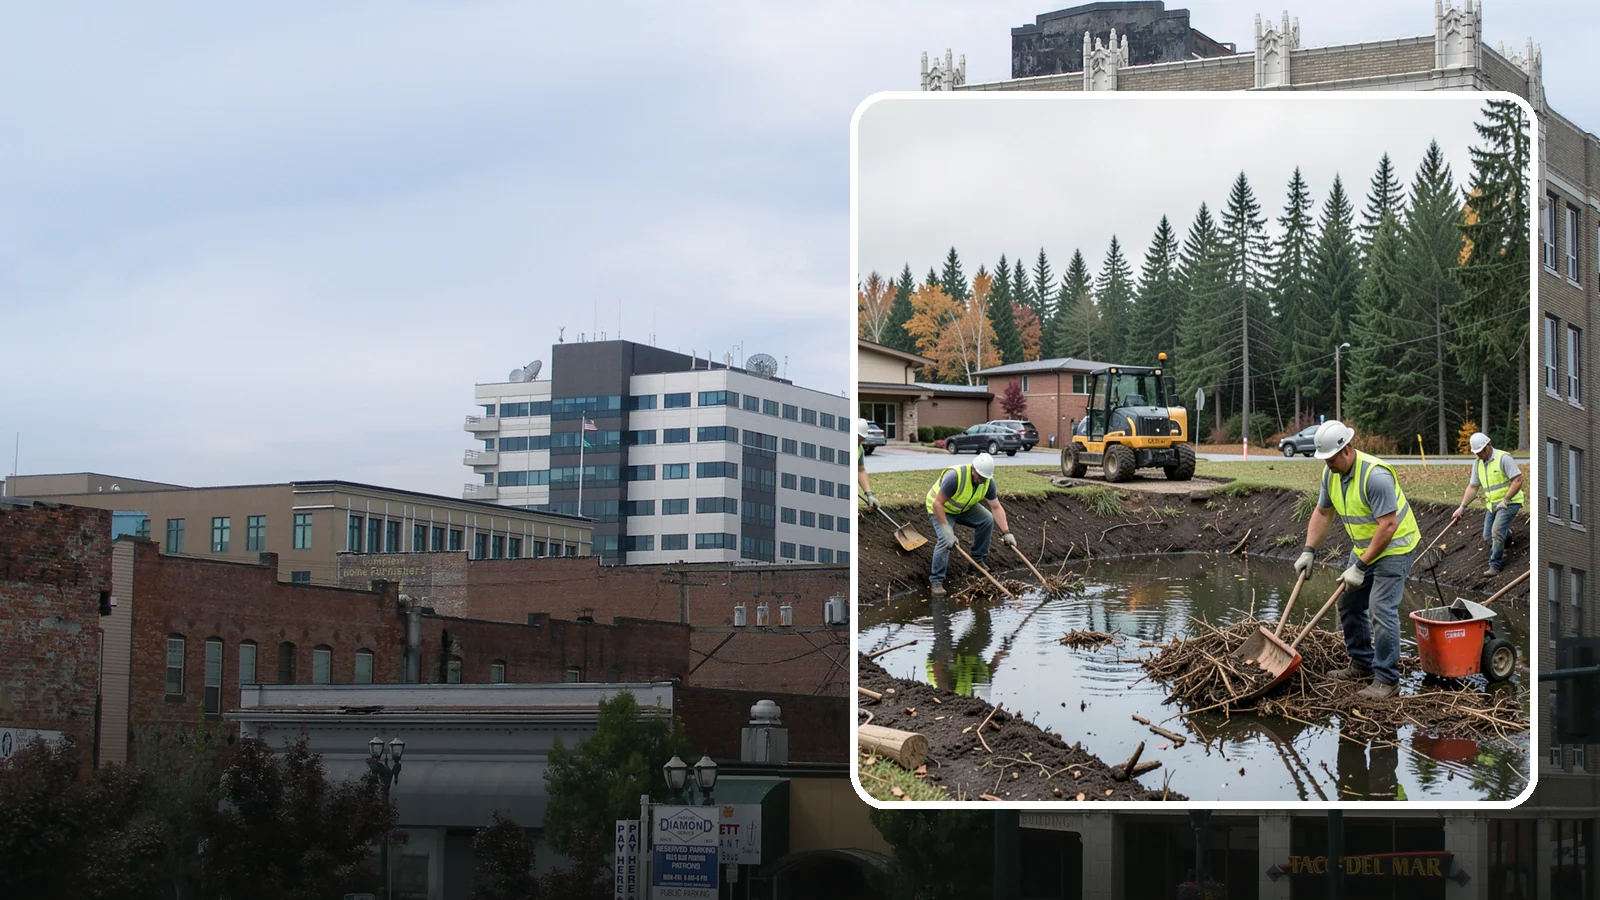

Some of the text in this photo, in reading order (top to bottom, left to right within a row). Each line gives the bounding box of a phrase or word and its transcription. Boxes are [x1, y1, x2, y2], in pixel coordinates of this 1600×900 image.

[370, 566, 426, 576] Furnishers
[660, 818, 713, 833] DIAMOND
[1022, 815, 1070, 828] BUILDING
[719, 824, 740, 835] ETT
[718, 839, 740, 849] ANT
[689, 846, 716, 854] PARKING
[616, 825, 625, 894] PAY HERE
[628, 824, 638, 894] PAY HERE
[671, 862, 701, 870] PATRONS
[1289, 855, 1442, 877] TAC DEL MAR
[660, 888, 710, 898] PUBLIC PARKING
